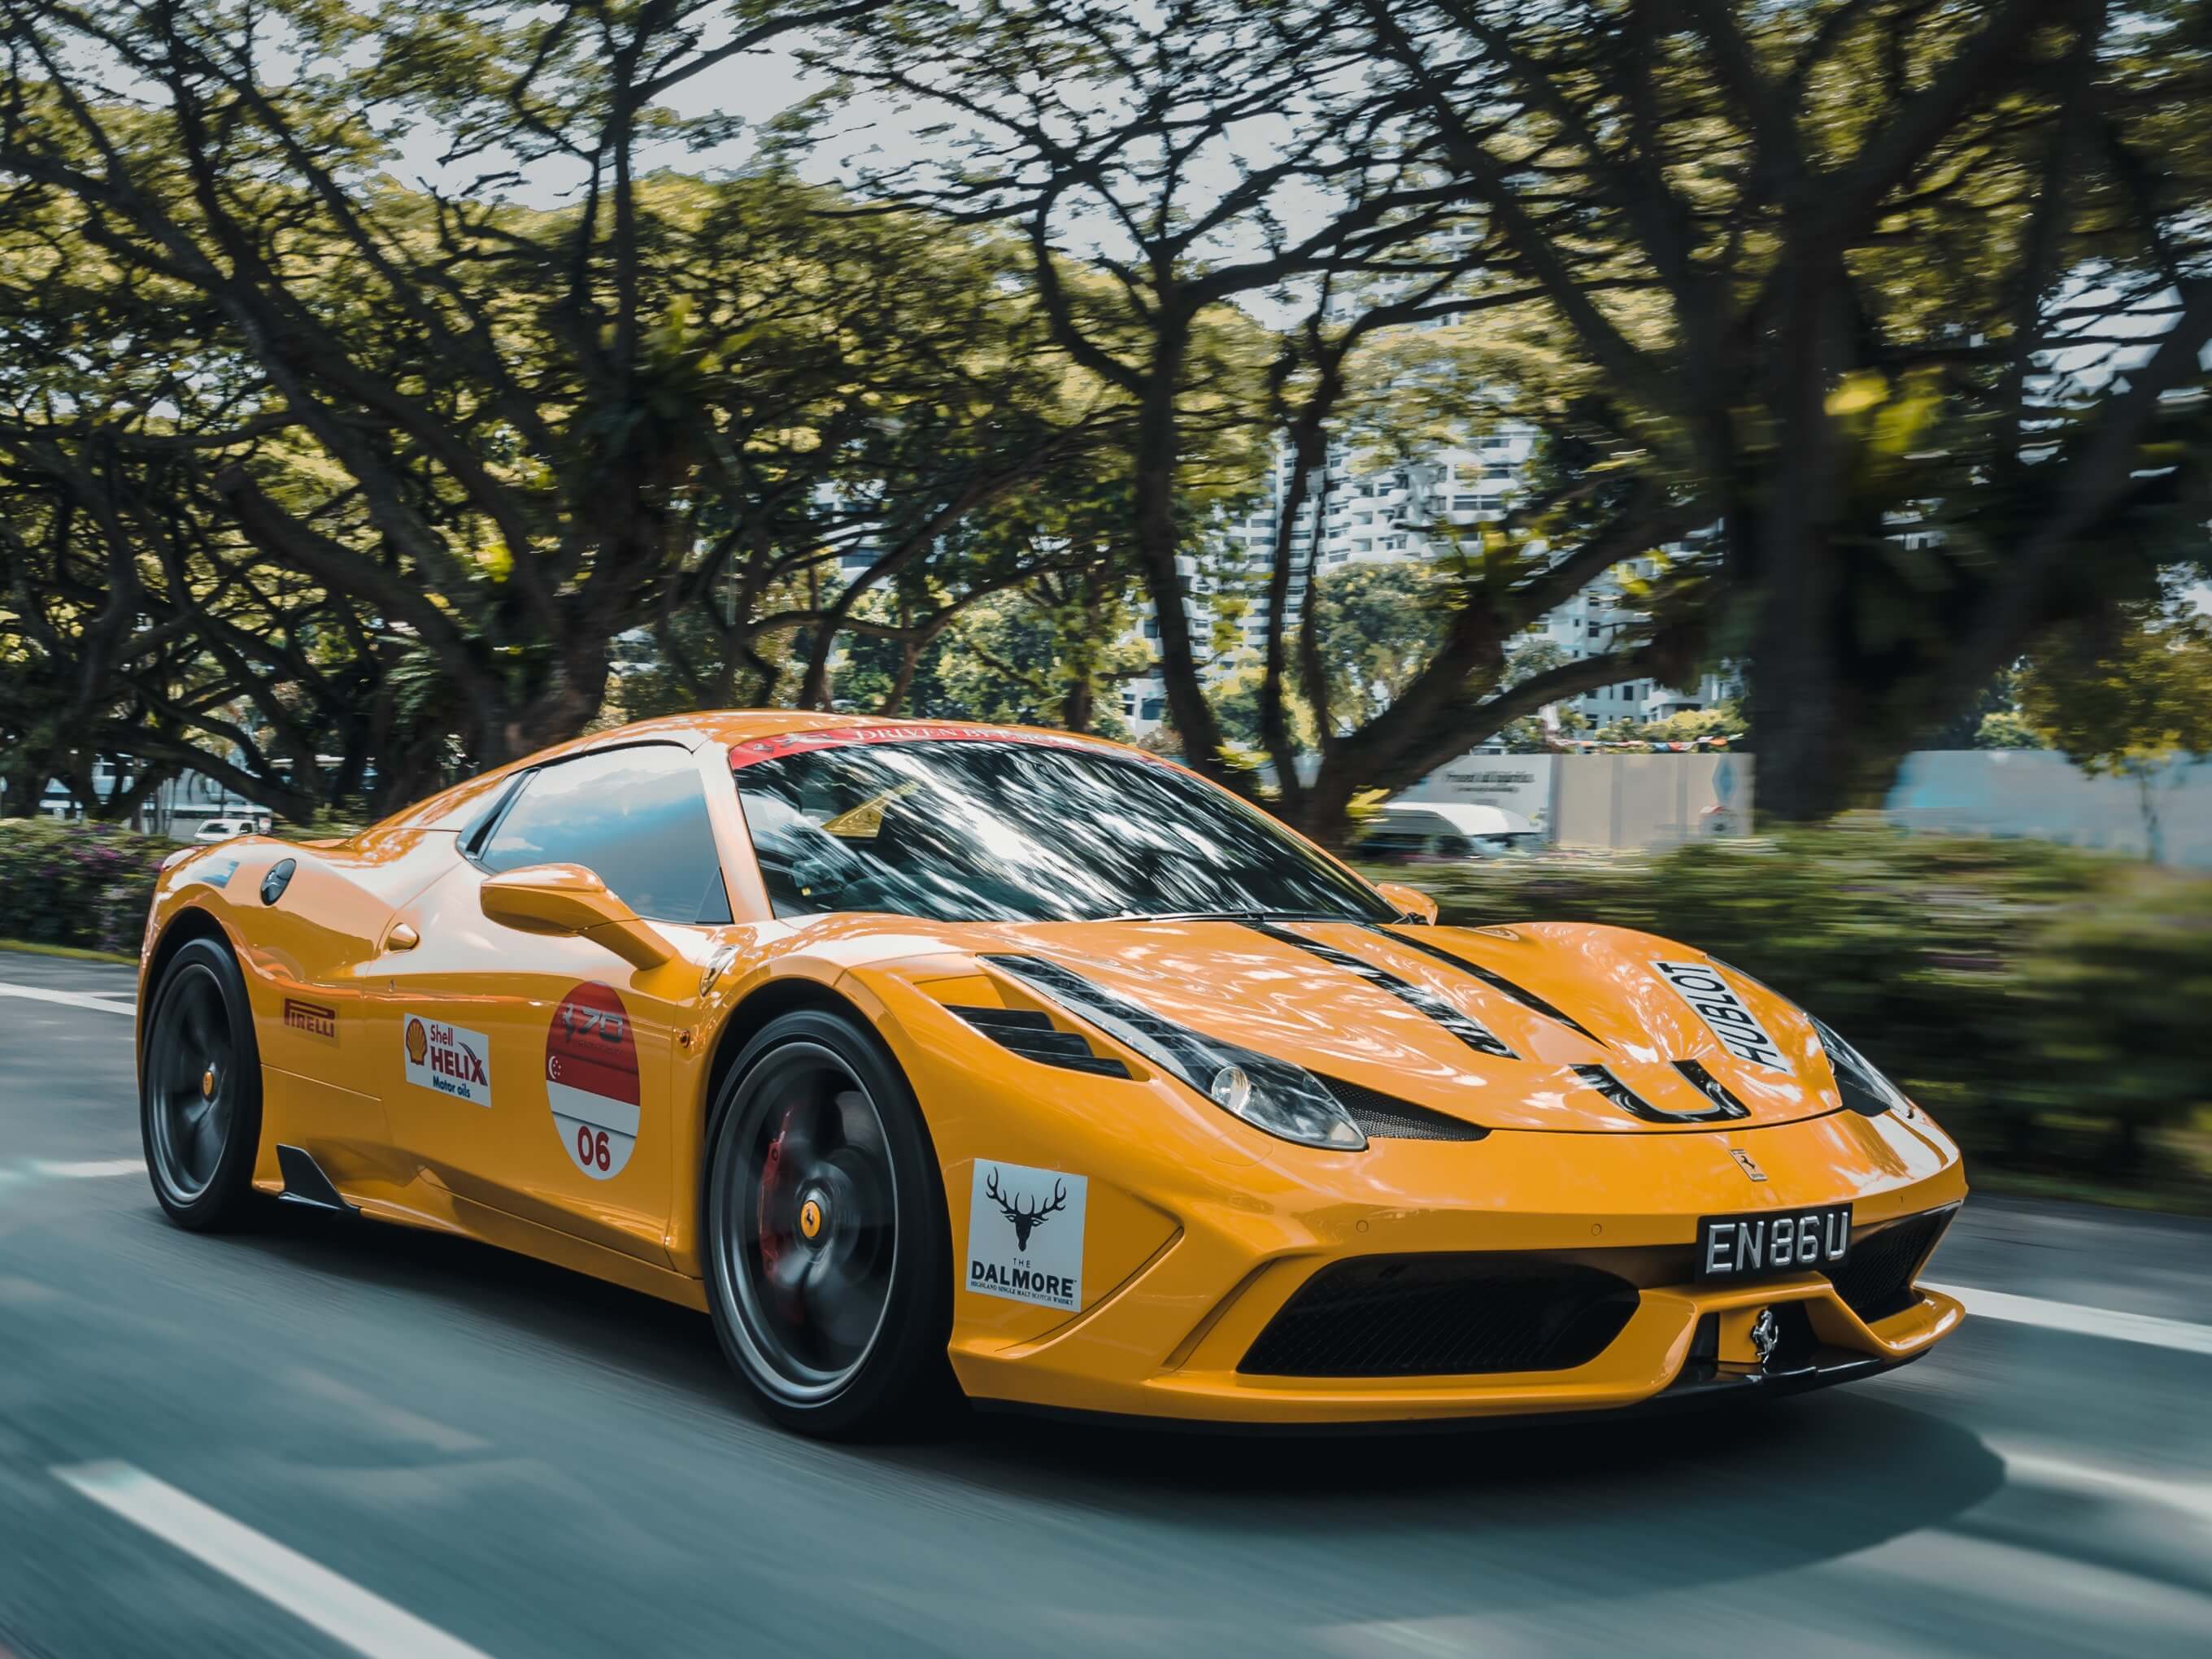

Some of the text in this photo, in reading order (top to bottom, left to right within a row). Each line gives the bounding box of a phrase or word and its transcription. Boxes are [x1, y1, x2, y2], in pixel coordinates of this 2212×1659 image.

[854, 728, 959, 740] DRIVEN
[285, 998, 335, 1038] PIRELLI
[430, 1024, 454, 1047] Shell
[578, 1006, 624, 1044] 70
[1657, 963, 1787, 1072] HUBLOT
[430, 1044, 488, 1086] HELIX
[433, 1075, 471, 1099] Motor oils
[577, 1126, 611, 1172] 06
[1705, 1212, 1848, 1274] EN86U
[971, 1260, 1074, 1299] DALMORE
[1013, 1257, 1031, 1269] THE
